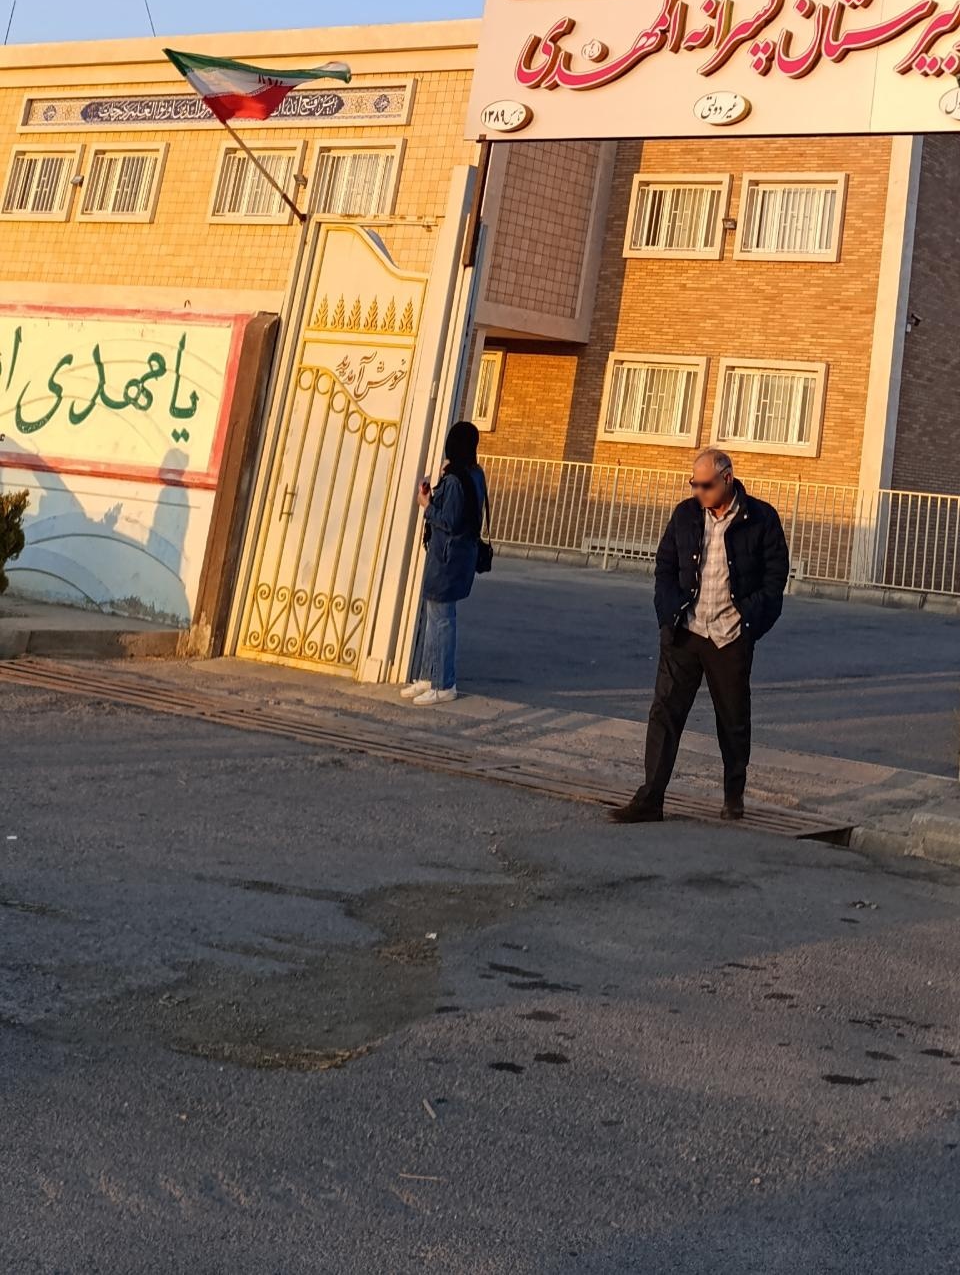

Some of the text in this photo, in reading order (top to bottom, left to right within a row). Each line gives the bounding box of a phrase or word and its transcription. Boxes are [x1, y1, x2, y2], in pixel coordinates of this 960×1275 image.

[484, 109, 504, 123] ۱۳۸۹
[700, 94, 738, 119] غیر دولتی
[15, 343, 167, 434] مهدی
[170, 332, 199, 443] یا
[354, 359, 407, 401] خوش
